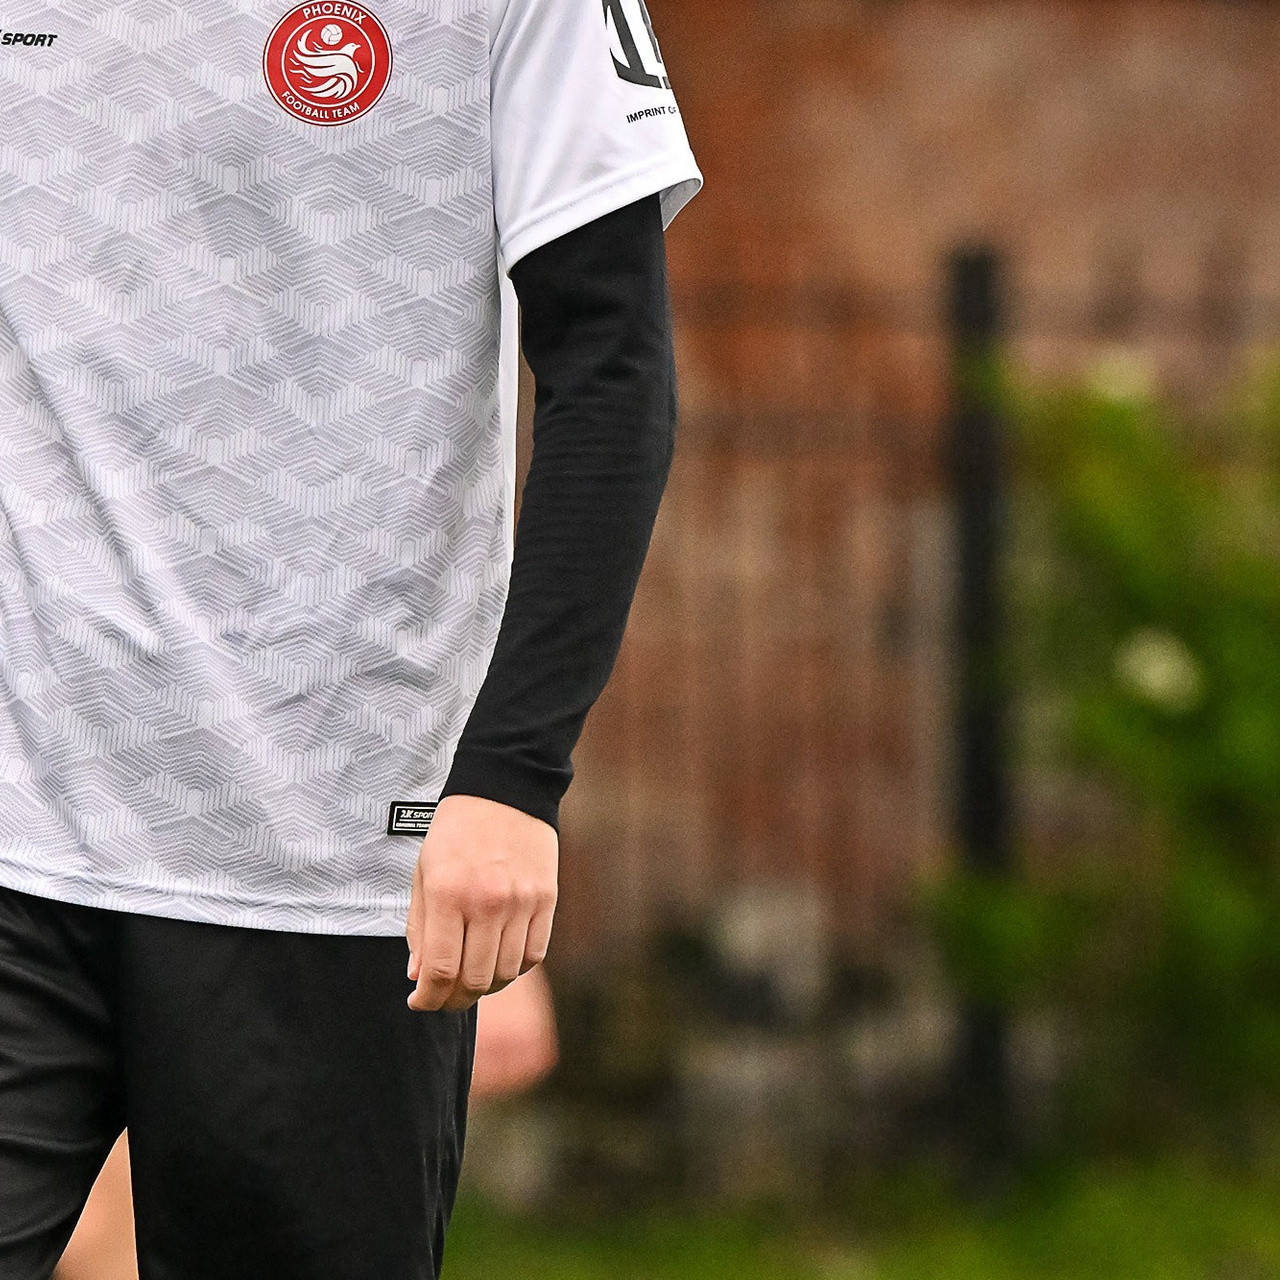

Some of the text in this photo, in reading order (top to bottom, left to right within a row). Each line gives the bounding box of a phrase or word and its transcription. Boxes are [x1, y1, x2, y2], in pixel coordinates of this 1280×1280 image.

[302, 3, 367, 24] PHOENIX
[1, 33, 58, 47] SPORT
[281, 91, 360, 119] FOOTBALL TEAM
[626, 106, 665, 124] IMPRINT
